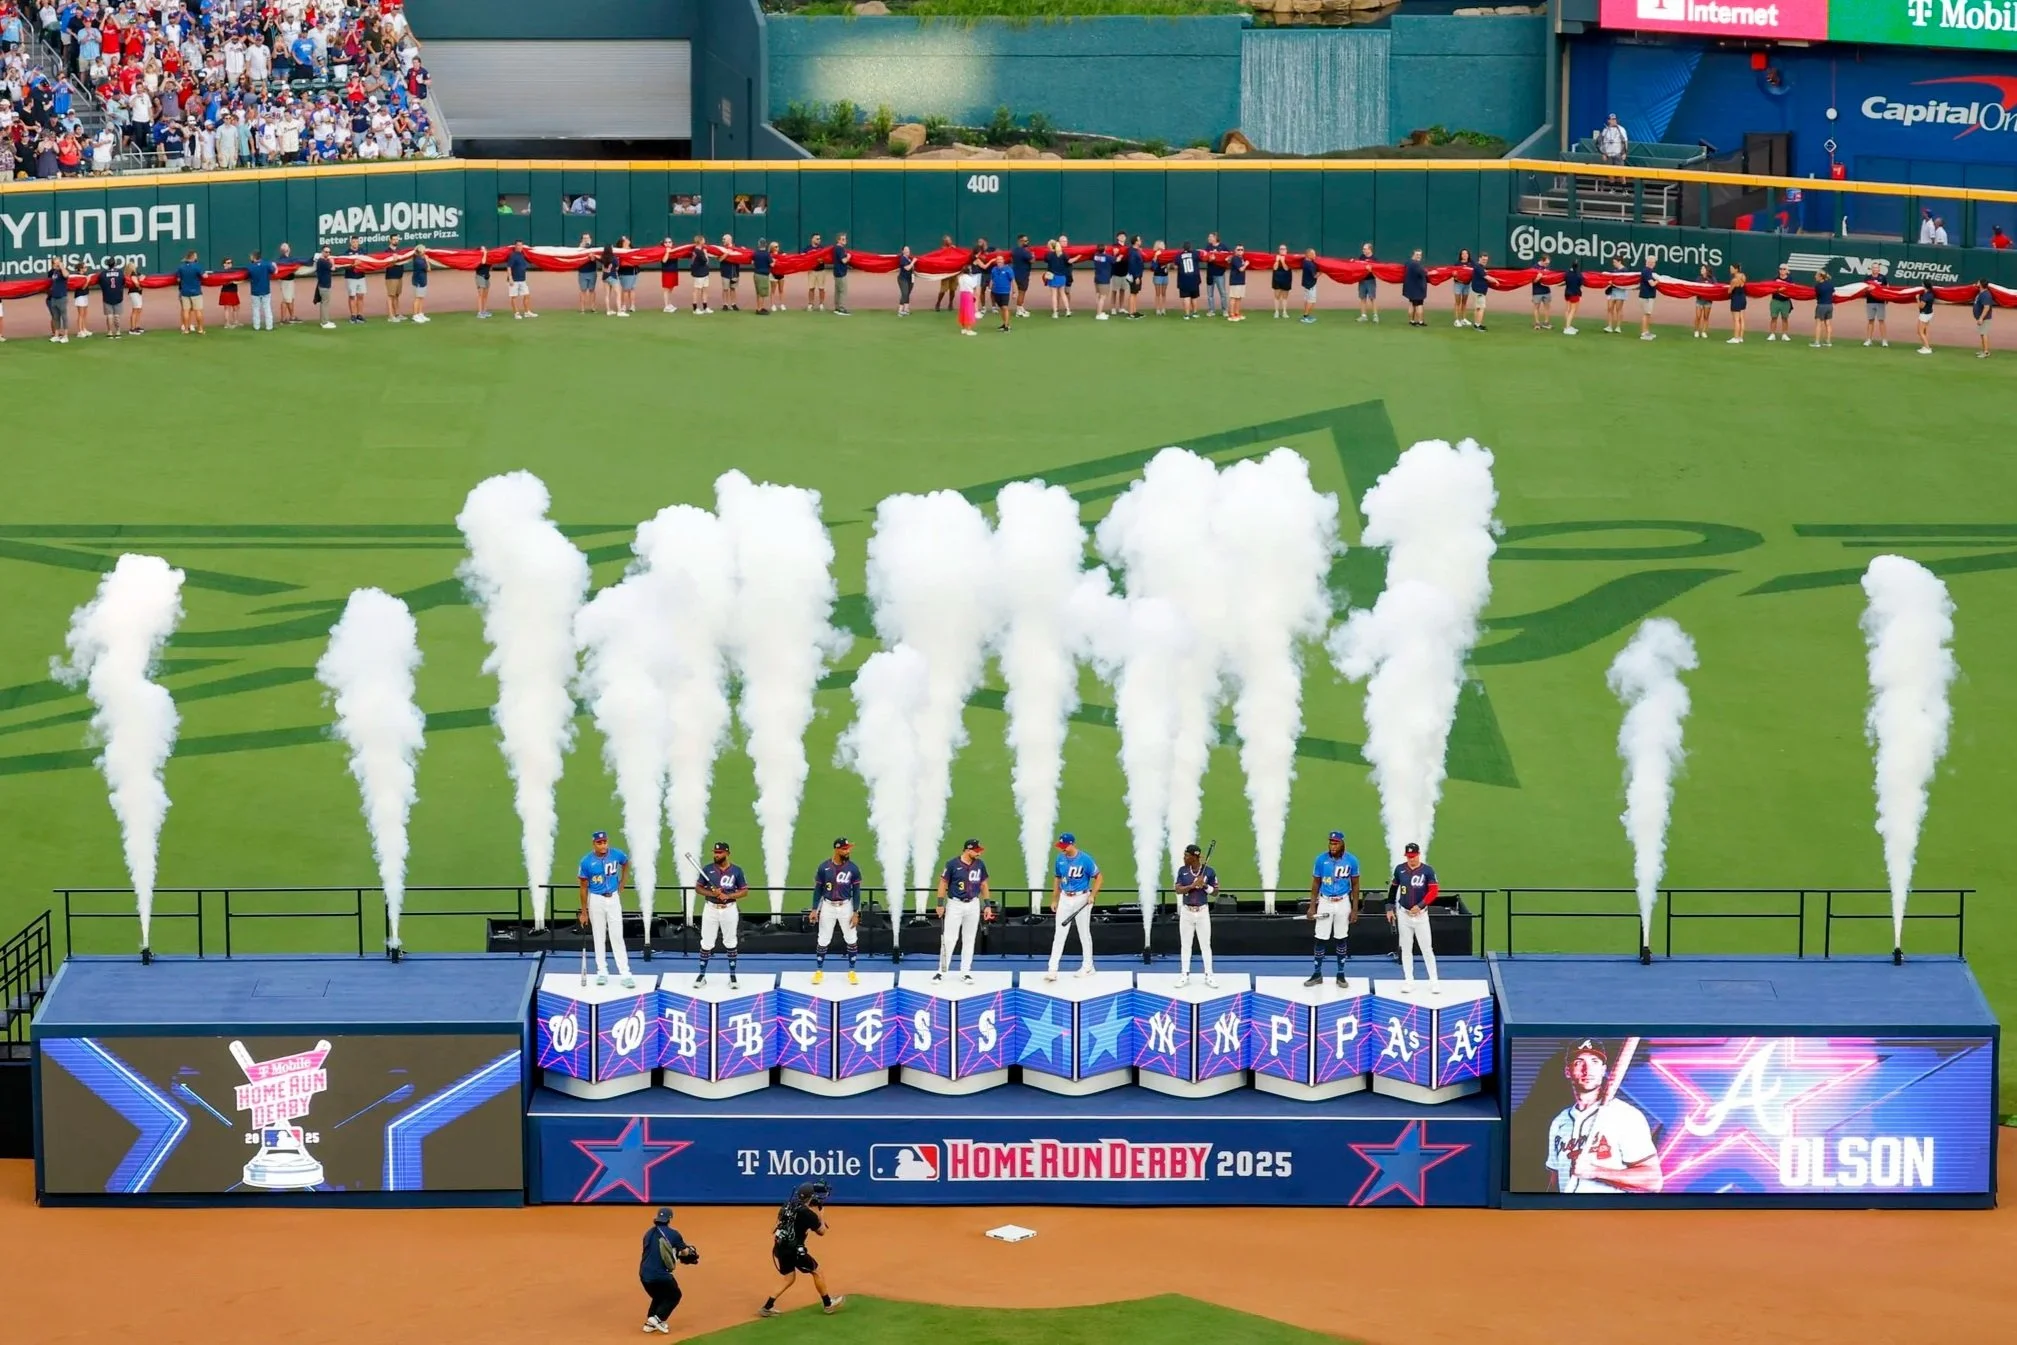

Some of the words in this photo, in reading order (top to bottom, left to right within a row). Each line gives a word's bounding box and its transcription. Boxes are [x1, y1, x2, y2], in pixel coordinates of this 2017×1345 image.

[1687, 1, 1780, 27] Internet
[967, 174, 999, 193] 400
[318, 205, 379, 235] PAPA
[380, 202, 460, 232] JOHNS
[319, 236, 348, 246] Better
[404, 231, 432, 241] Better
[433, 230, 459, 239] Pizza.
[1182, 258, 1195, 273] 10
[1894, 269, 1959, 283] SOUTHERN
[1897, 260, 1952, 274] NORFOLK
[913, 1009, 932, 1052] S
[978, 1009, 998, 1054] S
[1269, 1014, 1294, 1057] P
[1335, 1014, 1359, 1060] P
[239, 1080, 287, 1109] HOME
[305, 1132, 320, 1143] 25
[767, 1149, 861, 1176] Mobile
[950, 1142, 1035, 1179] HOME
[1040, 1142, 1099, 1179] RUN
[1109, 1142, 1210, 1179] DERBY
[1216, 1150, 1293, 1178] 2025
[1779, 1136, 1935, 1187] OLSON
